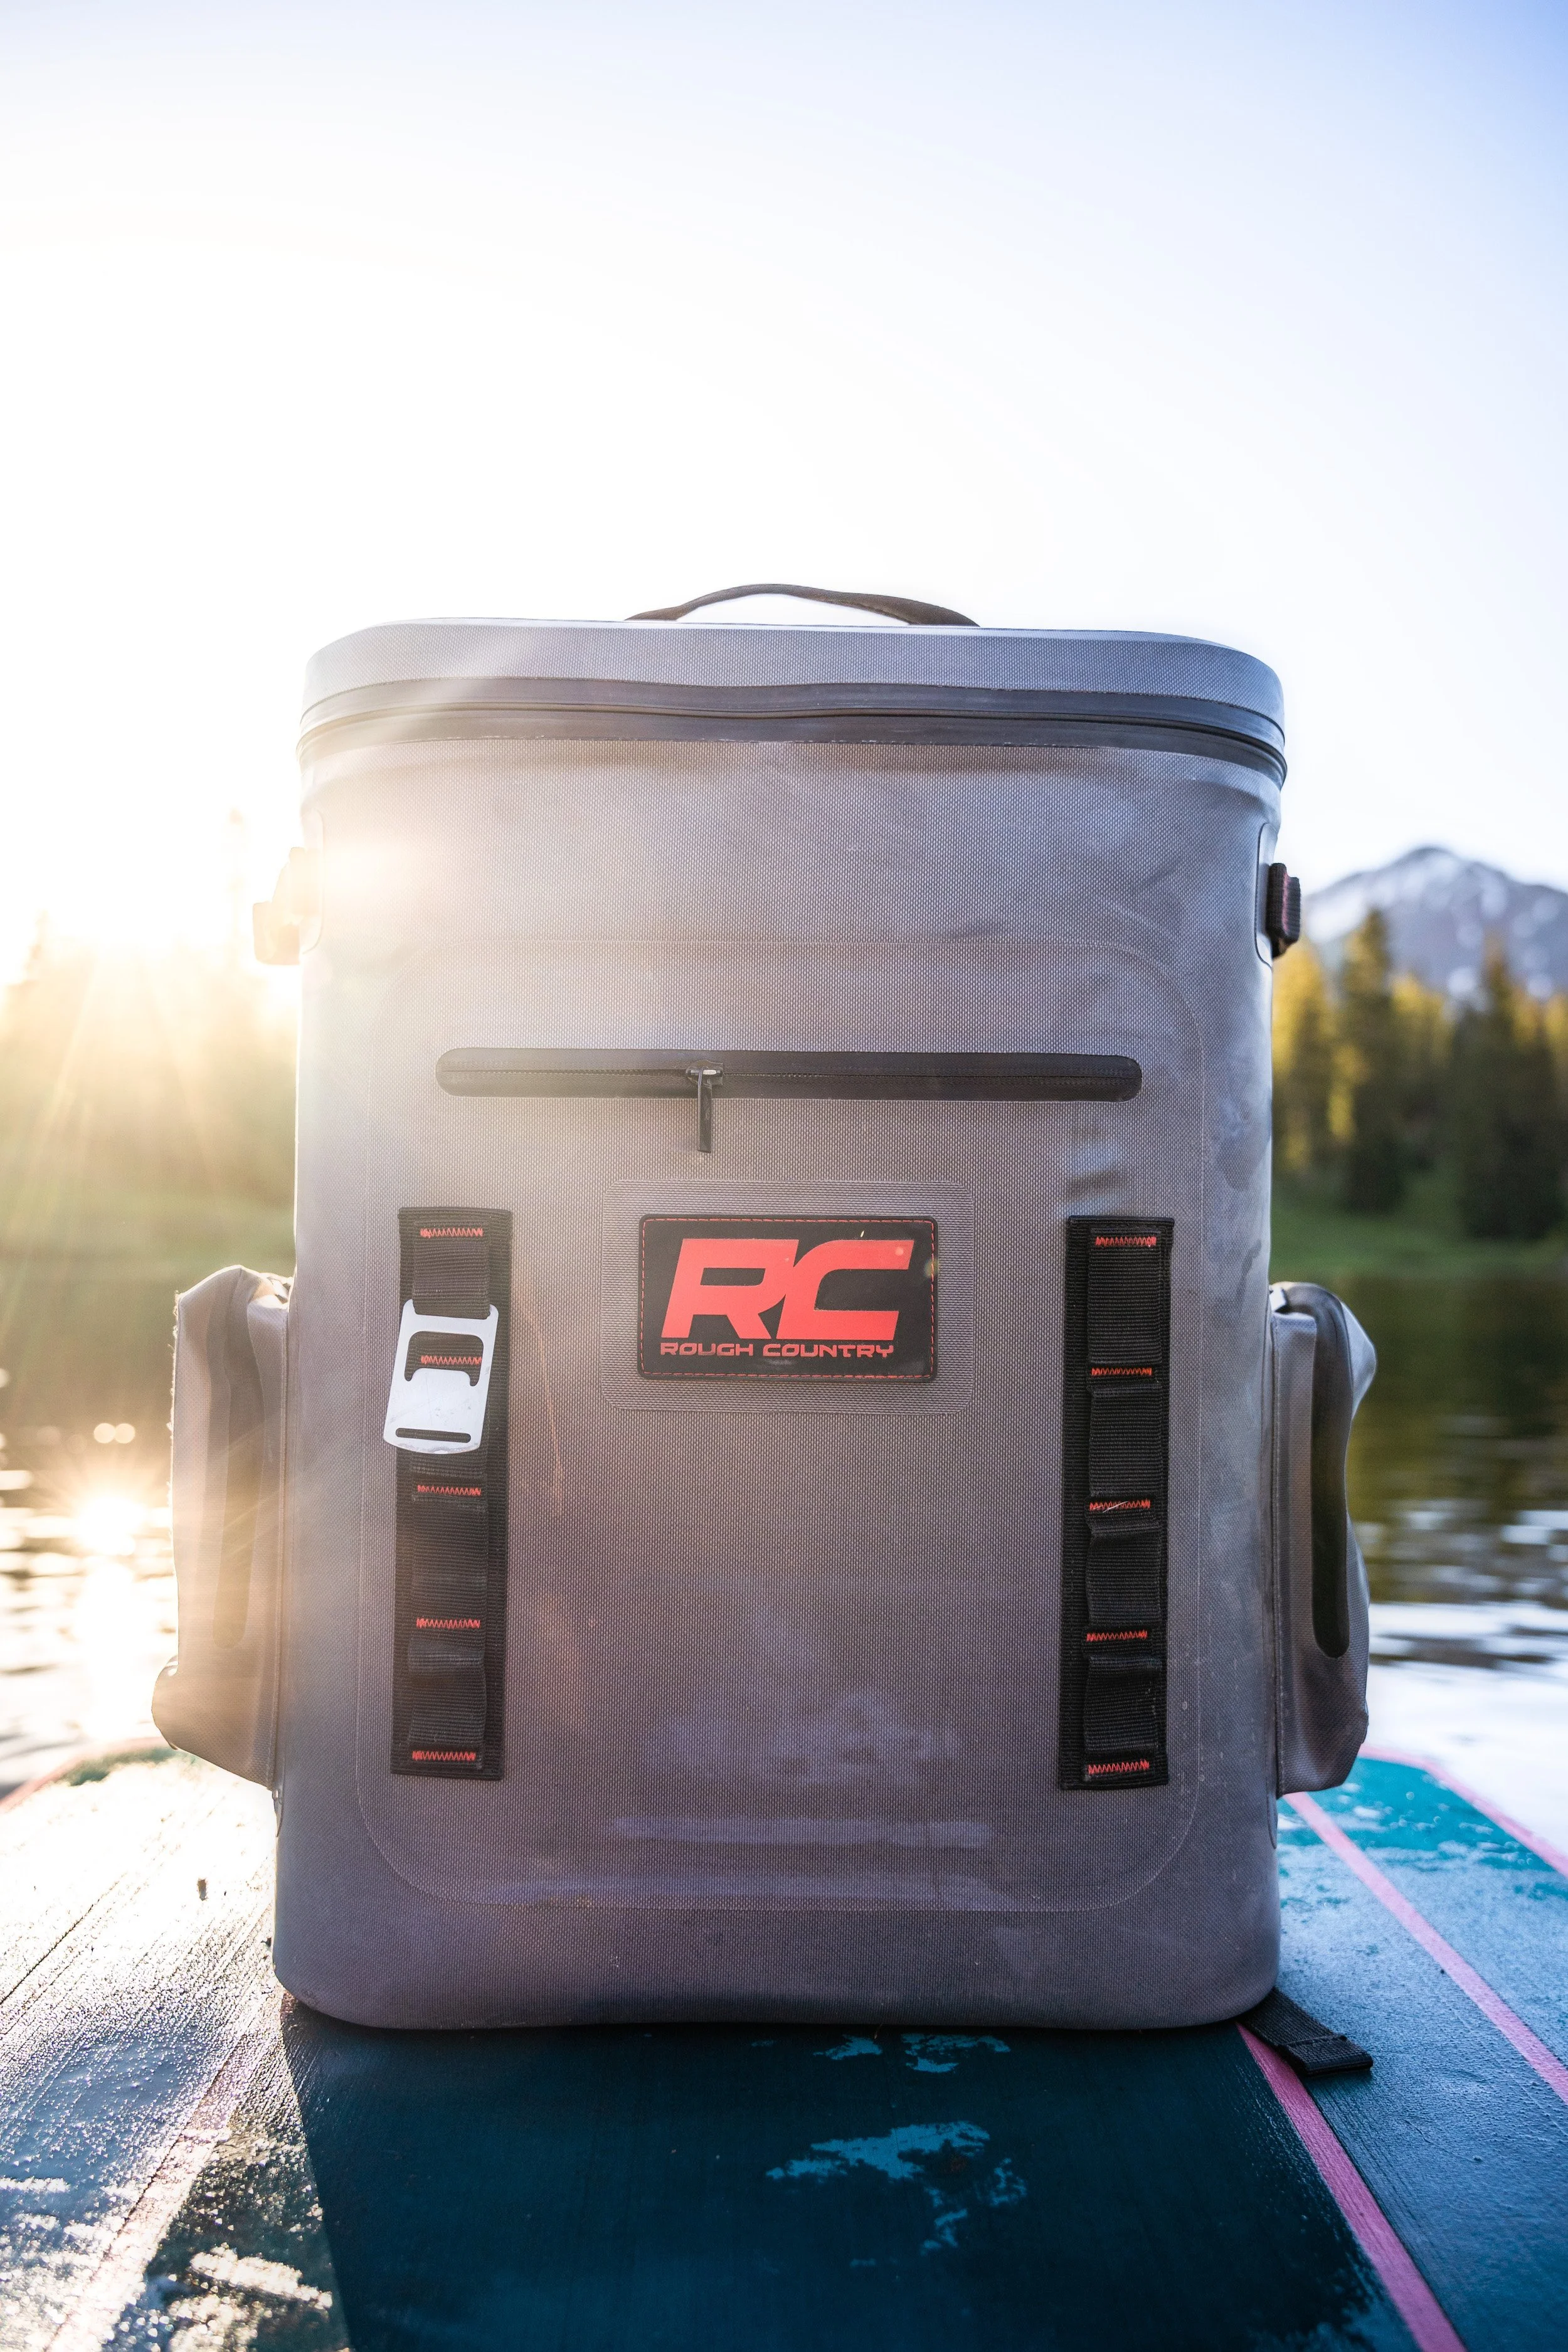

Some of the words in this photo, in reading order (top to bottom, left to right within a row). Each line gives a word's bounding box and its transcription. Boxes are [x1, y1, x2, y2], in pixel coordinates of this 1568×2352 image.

[661, 1238, 914, 1341] RC
[660, 1342, 753, 1357] ROUGH
[763, 1343, 894, 1358] COUNTRY
